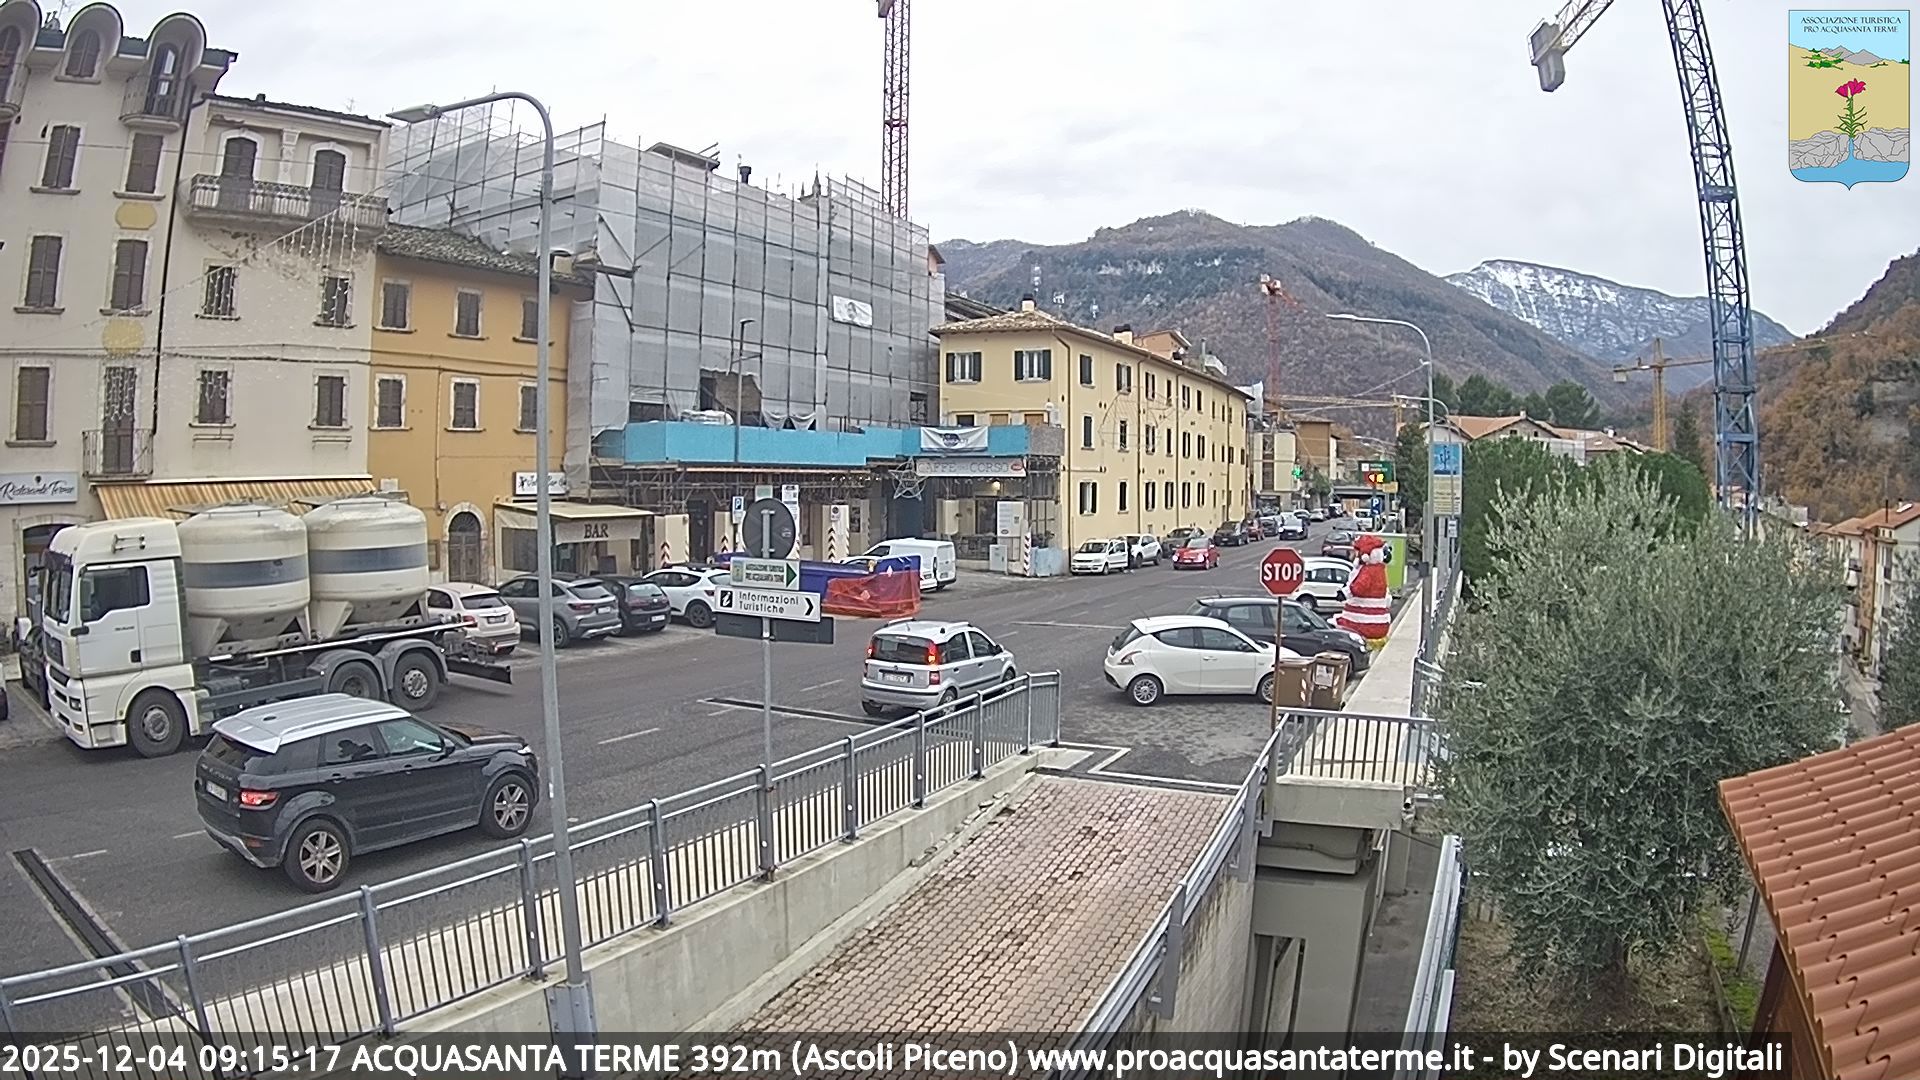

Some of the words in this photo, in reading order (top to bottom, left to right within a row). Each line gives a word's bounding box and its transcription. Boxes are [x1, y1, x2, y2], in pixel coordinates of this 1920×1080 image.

[584, 524, 609, 539] BAR
[1263, 563, 1302, 581] STOP
[739, 591, 799, 605] Informazioni
[739, 601, 785, 614] Turistiche
